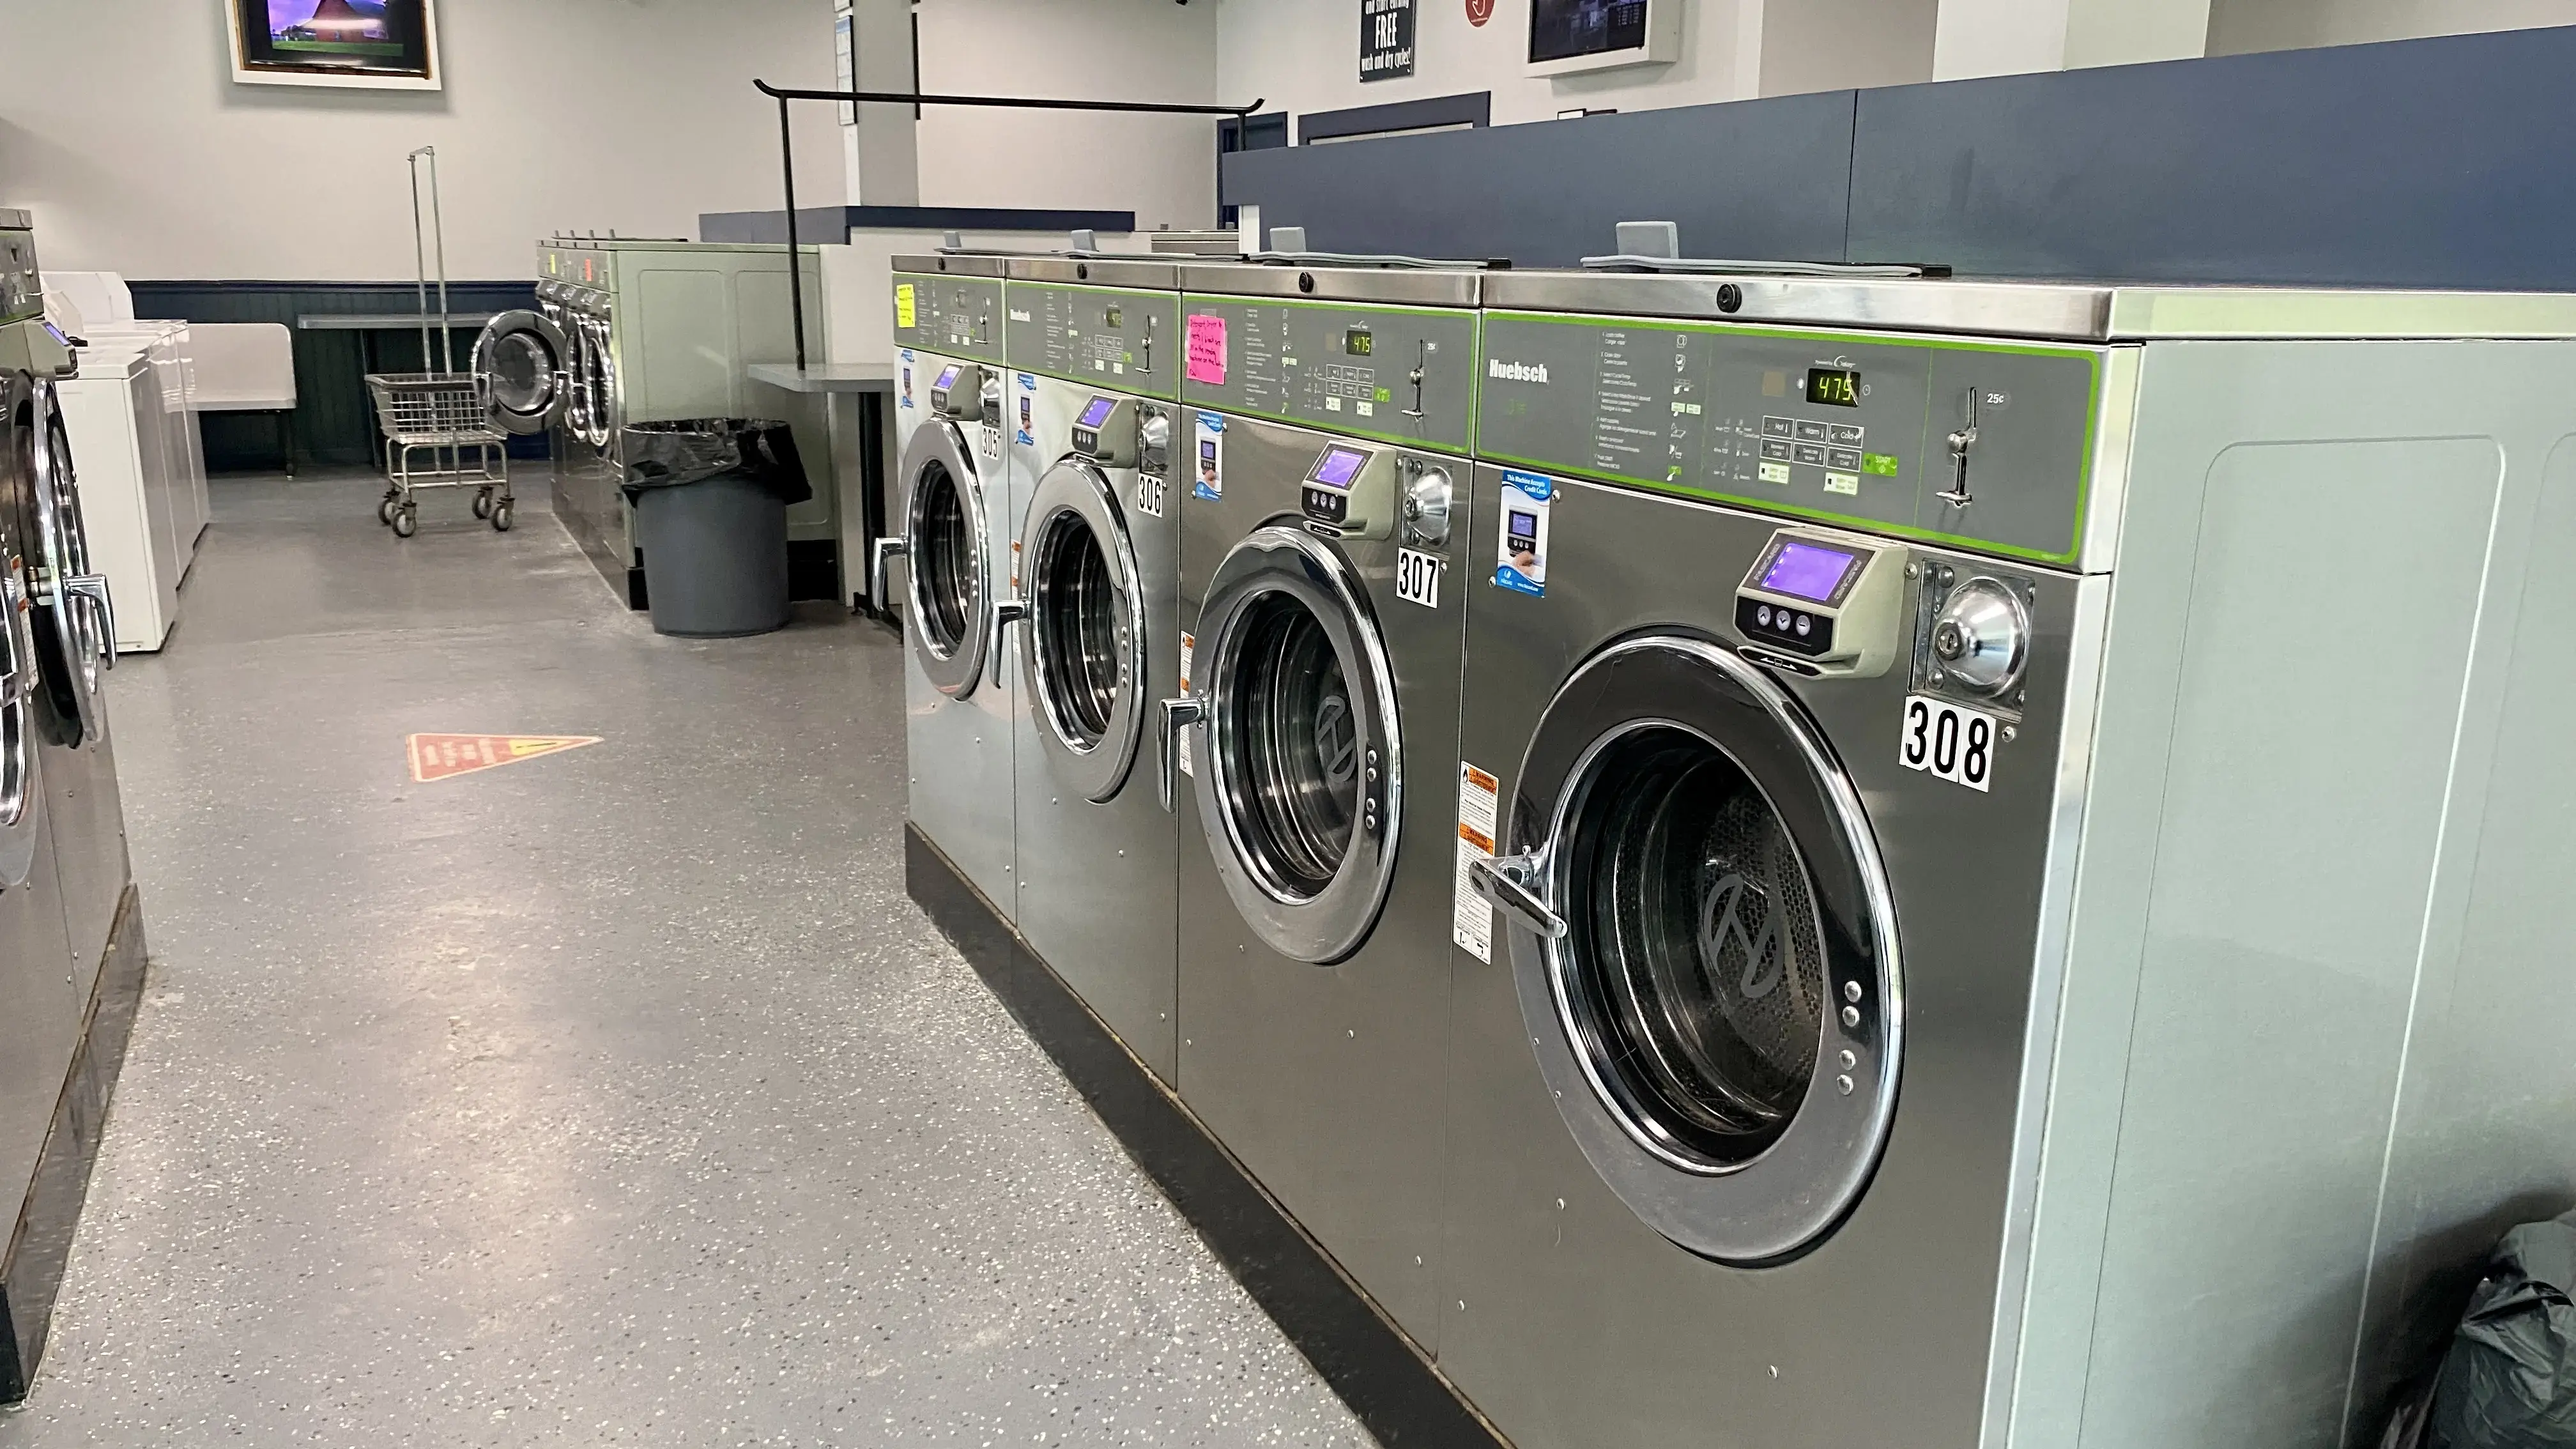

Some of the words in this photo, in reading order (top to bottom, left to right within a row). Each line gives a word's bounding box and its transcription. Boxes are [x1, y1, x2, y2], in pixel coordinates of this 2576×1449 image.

[1375, 12, 1397, 49] FREE
[1489, 358, 1548, 383] Huebsch
[1987, 393, 2004, 404] 25¢
[983, 427, 997, 457] 305
[1139, 476, 1161, 514] 306
[1399, 552, 1437, 604] 307
[1906, 701, 1989, 784] 308
